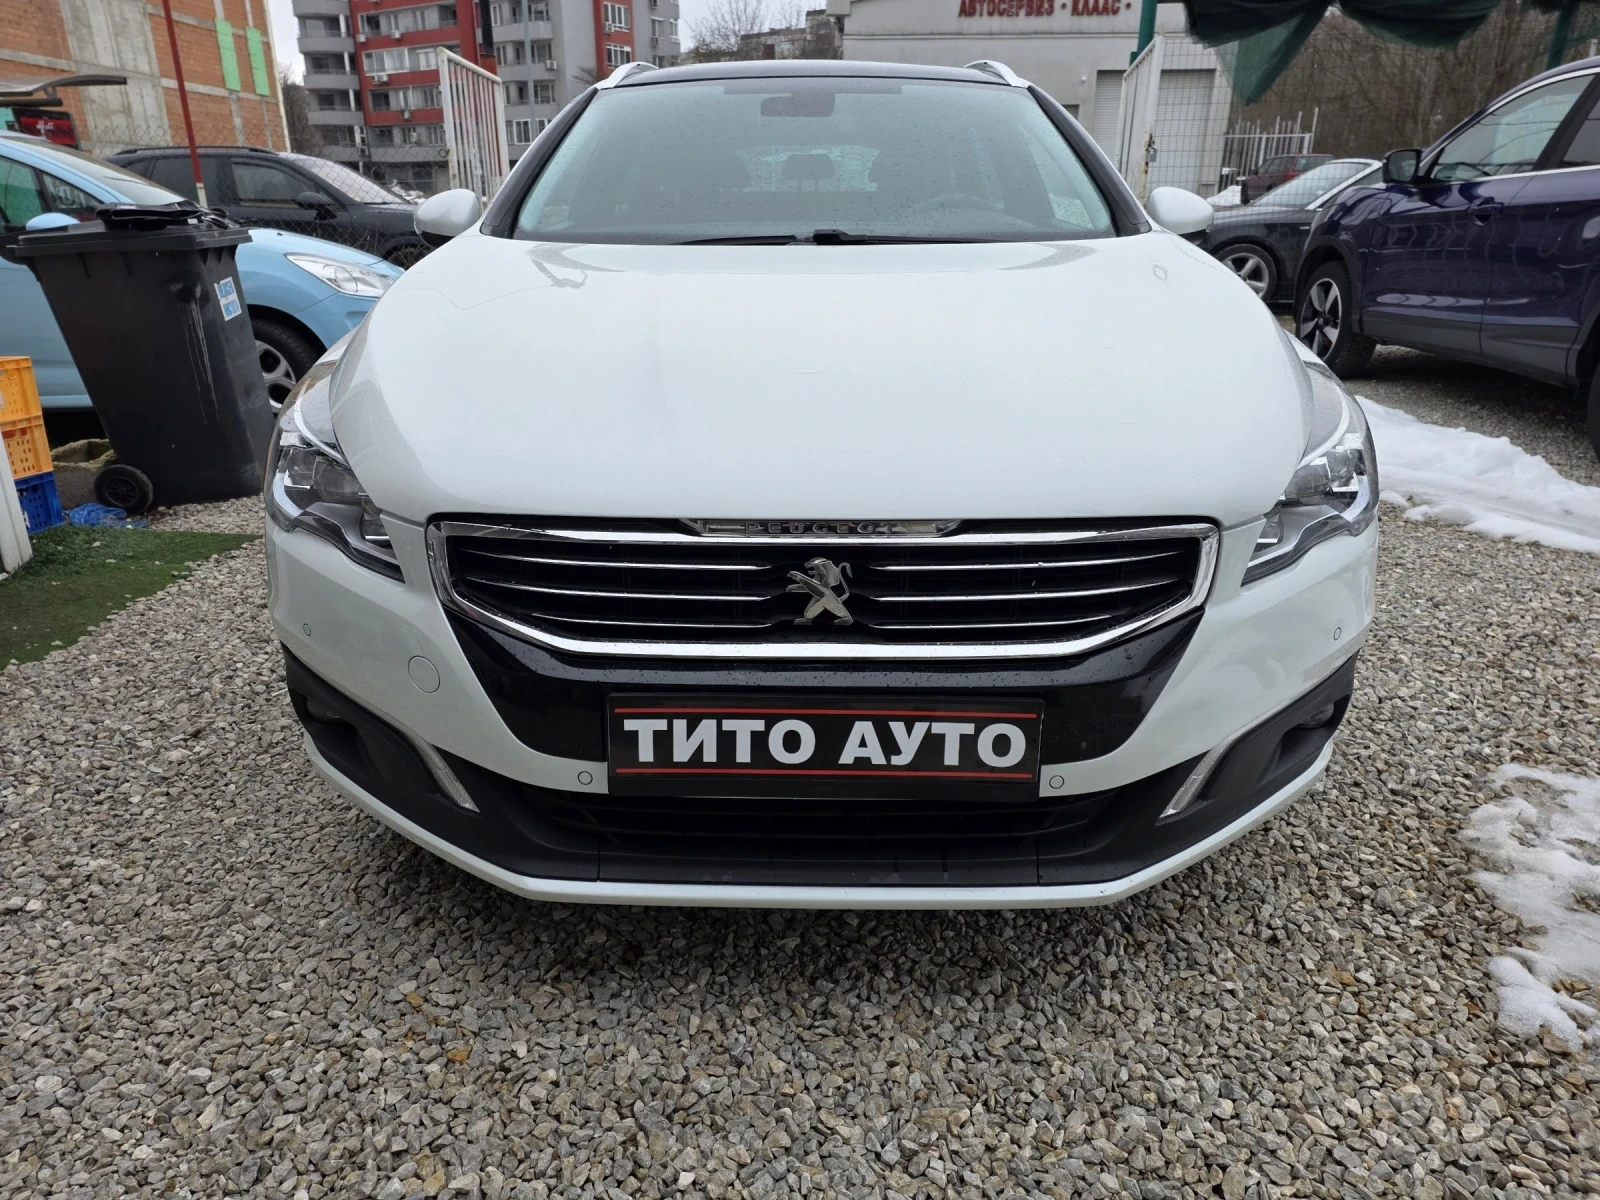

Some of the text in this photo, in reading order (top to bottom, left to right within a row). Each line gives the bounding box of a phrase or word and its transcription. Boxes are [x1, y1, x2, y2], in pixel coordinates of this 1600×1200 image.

[745, 522, 897, 534] PEUGEOT
[623, 718, 1027, 768] ТИТО АУТО
